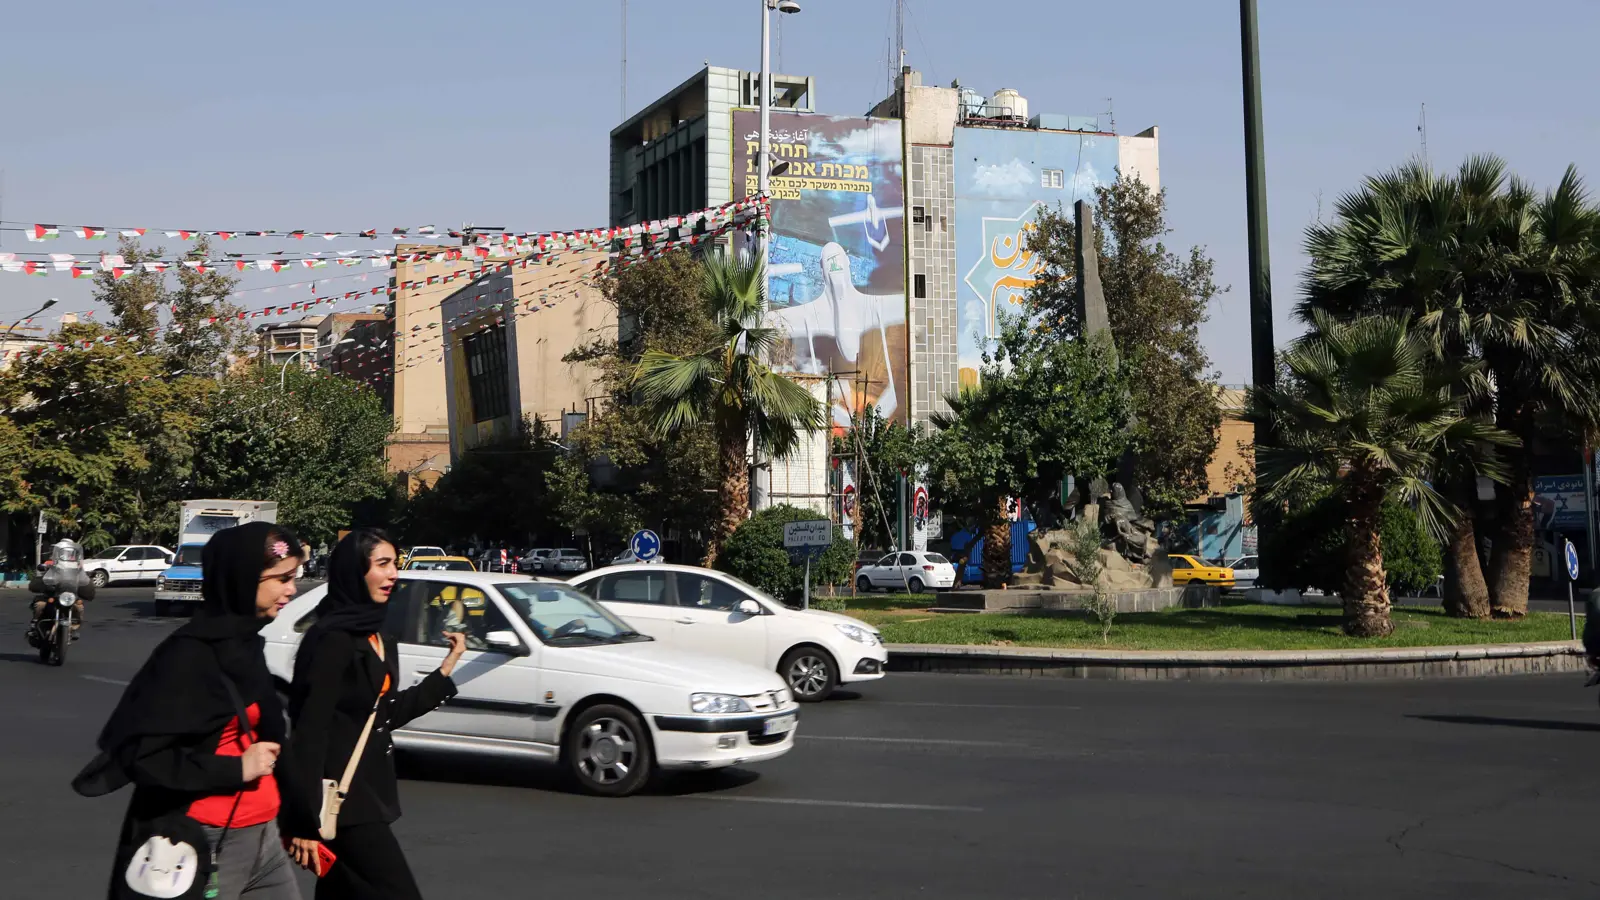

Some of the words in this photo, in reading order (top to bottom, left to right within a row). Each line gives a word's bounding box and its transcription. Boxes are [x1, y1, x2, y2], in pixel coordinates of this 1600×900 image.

[744, 130, 791, 142] خونخهی
[791, 129, 808, 143] آغاز
[747, 141, 808, 158] תחית
[822, 162, 869, 179] מכות
[789, 179, 808, 188] לכם
[810, 181, 837, 191] משקר
[840, 183, 870, 192] נתניהו
[778, 189, 800, 199] להגן
[788, 523, 810, 535] فلسطین
